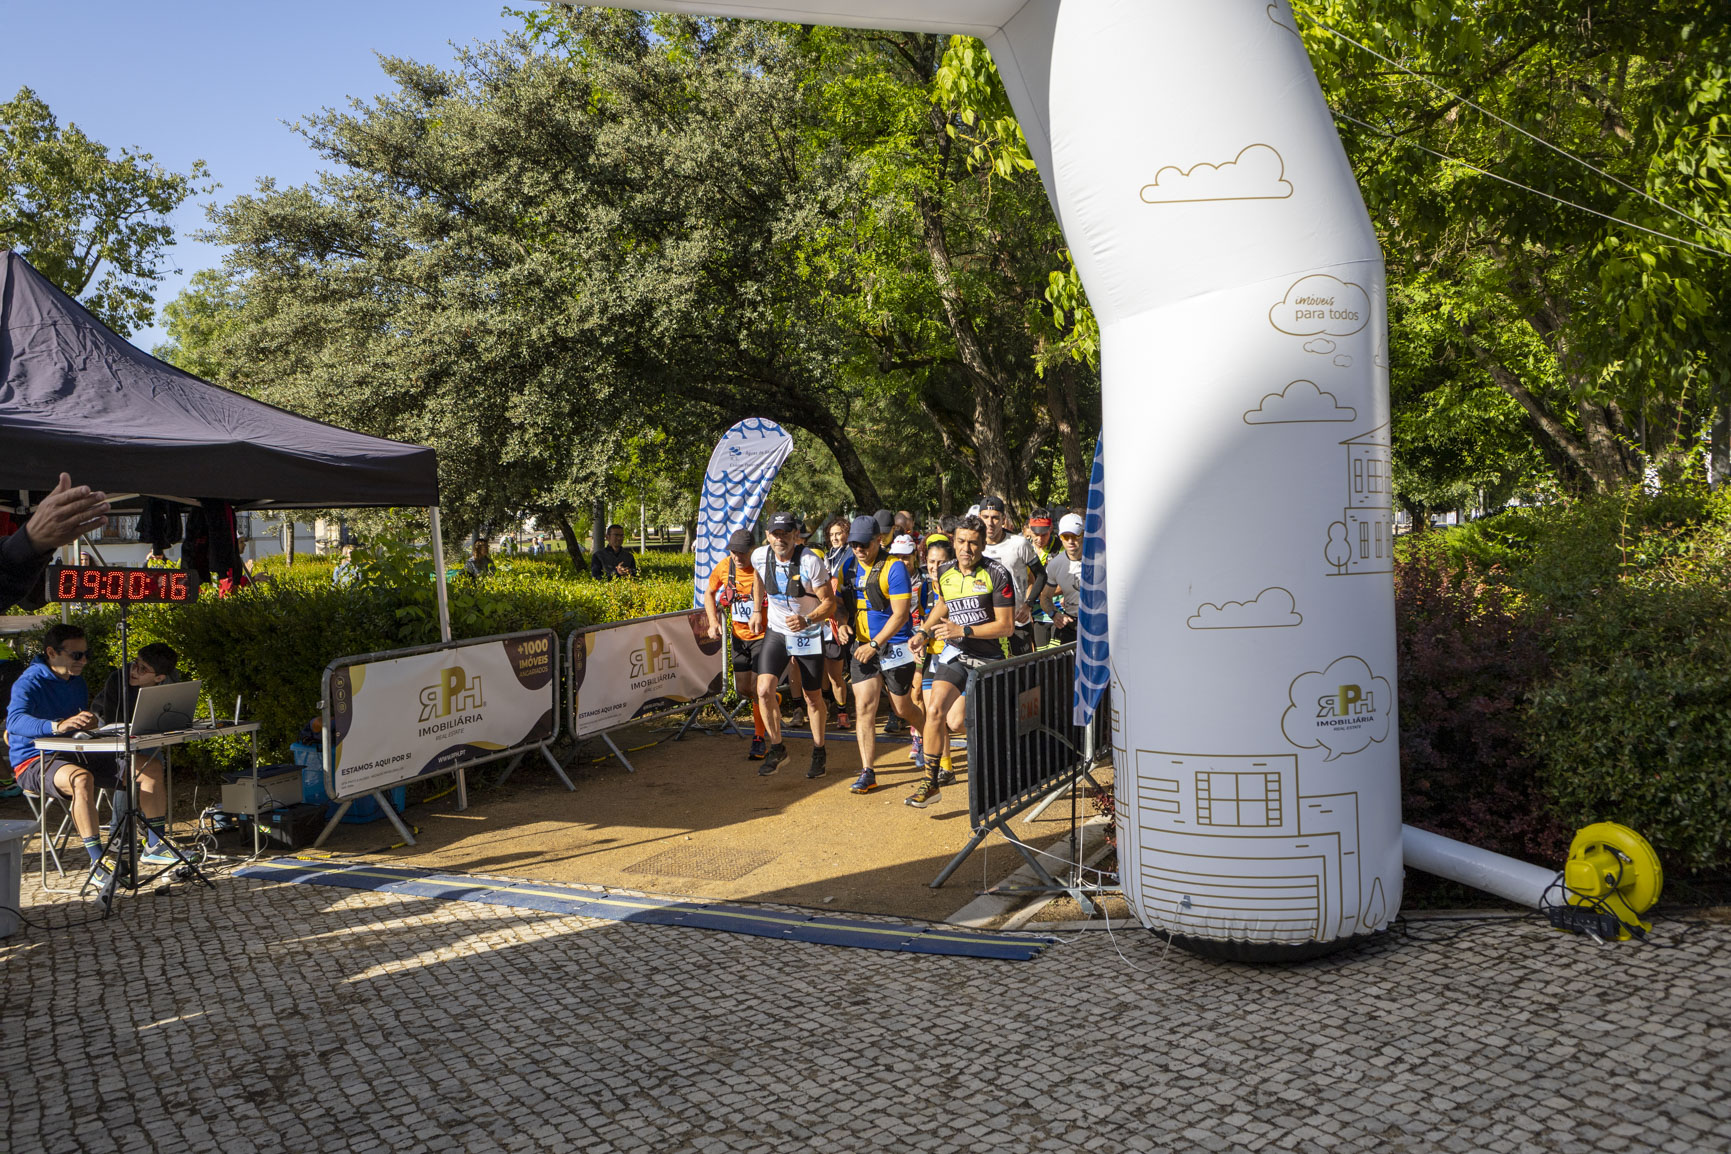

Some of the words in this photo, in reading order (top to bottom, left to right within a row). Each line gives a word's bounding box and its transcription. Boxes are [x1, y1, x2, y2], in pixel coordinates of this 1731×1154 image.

[1295, 294, 1334, 306] imóveis
[1295, 310, 1325, 321] para
[1329, 308, 1359, 320] todos
[58, 569, 188, 600] 09:00:16
[947, 598, 980, 612] RILHO
[518, 638, 548, 656] +1000
[797, 637, 810, 647] 82
[890, 648, 903, 660] 36
[519, 655, 548, 669] IMÓVEIS
[630, 672, 676, 690] IMOBILIÁRIA
[579, 708, 600, 719] ESTAMOS
[601, 706, 612, 714] AQUI
[418, 713, 483, 737] IMOBILIÁRIA
[1316, 716, 1374, 727] IMOBILIÁRIA
[436, 733, 447, 741] REAL
[448, 728, 464, 738] ESTATE
[341, 761, 374, 776] ESTAMOS
[375, 757, 391, 768] AQUI
[392, 754, 405, 765] POR
[406, 752, 412, 760] SI
